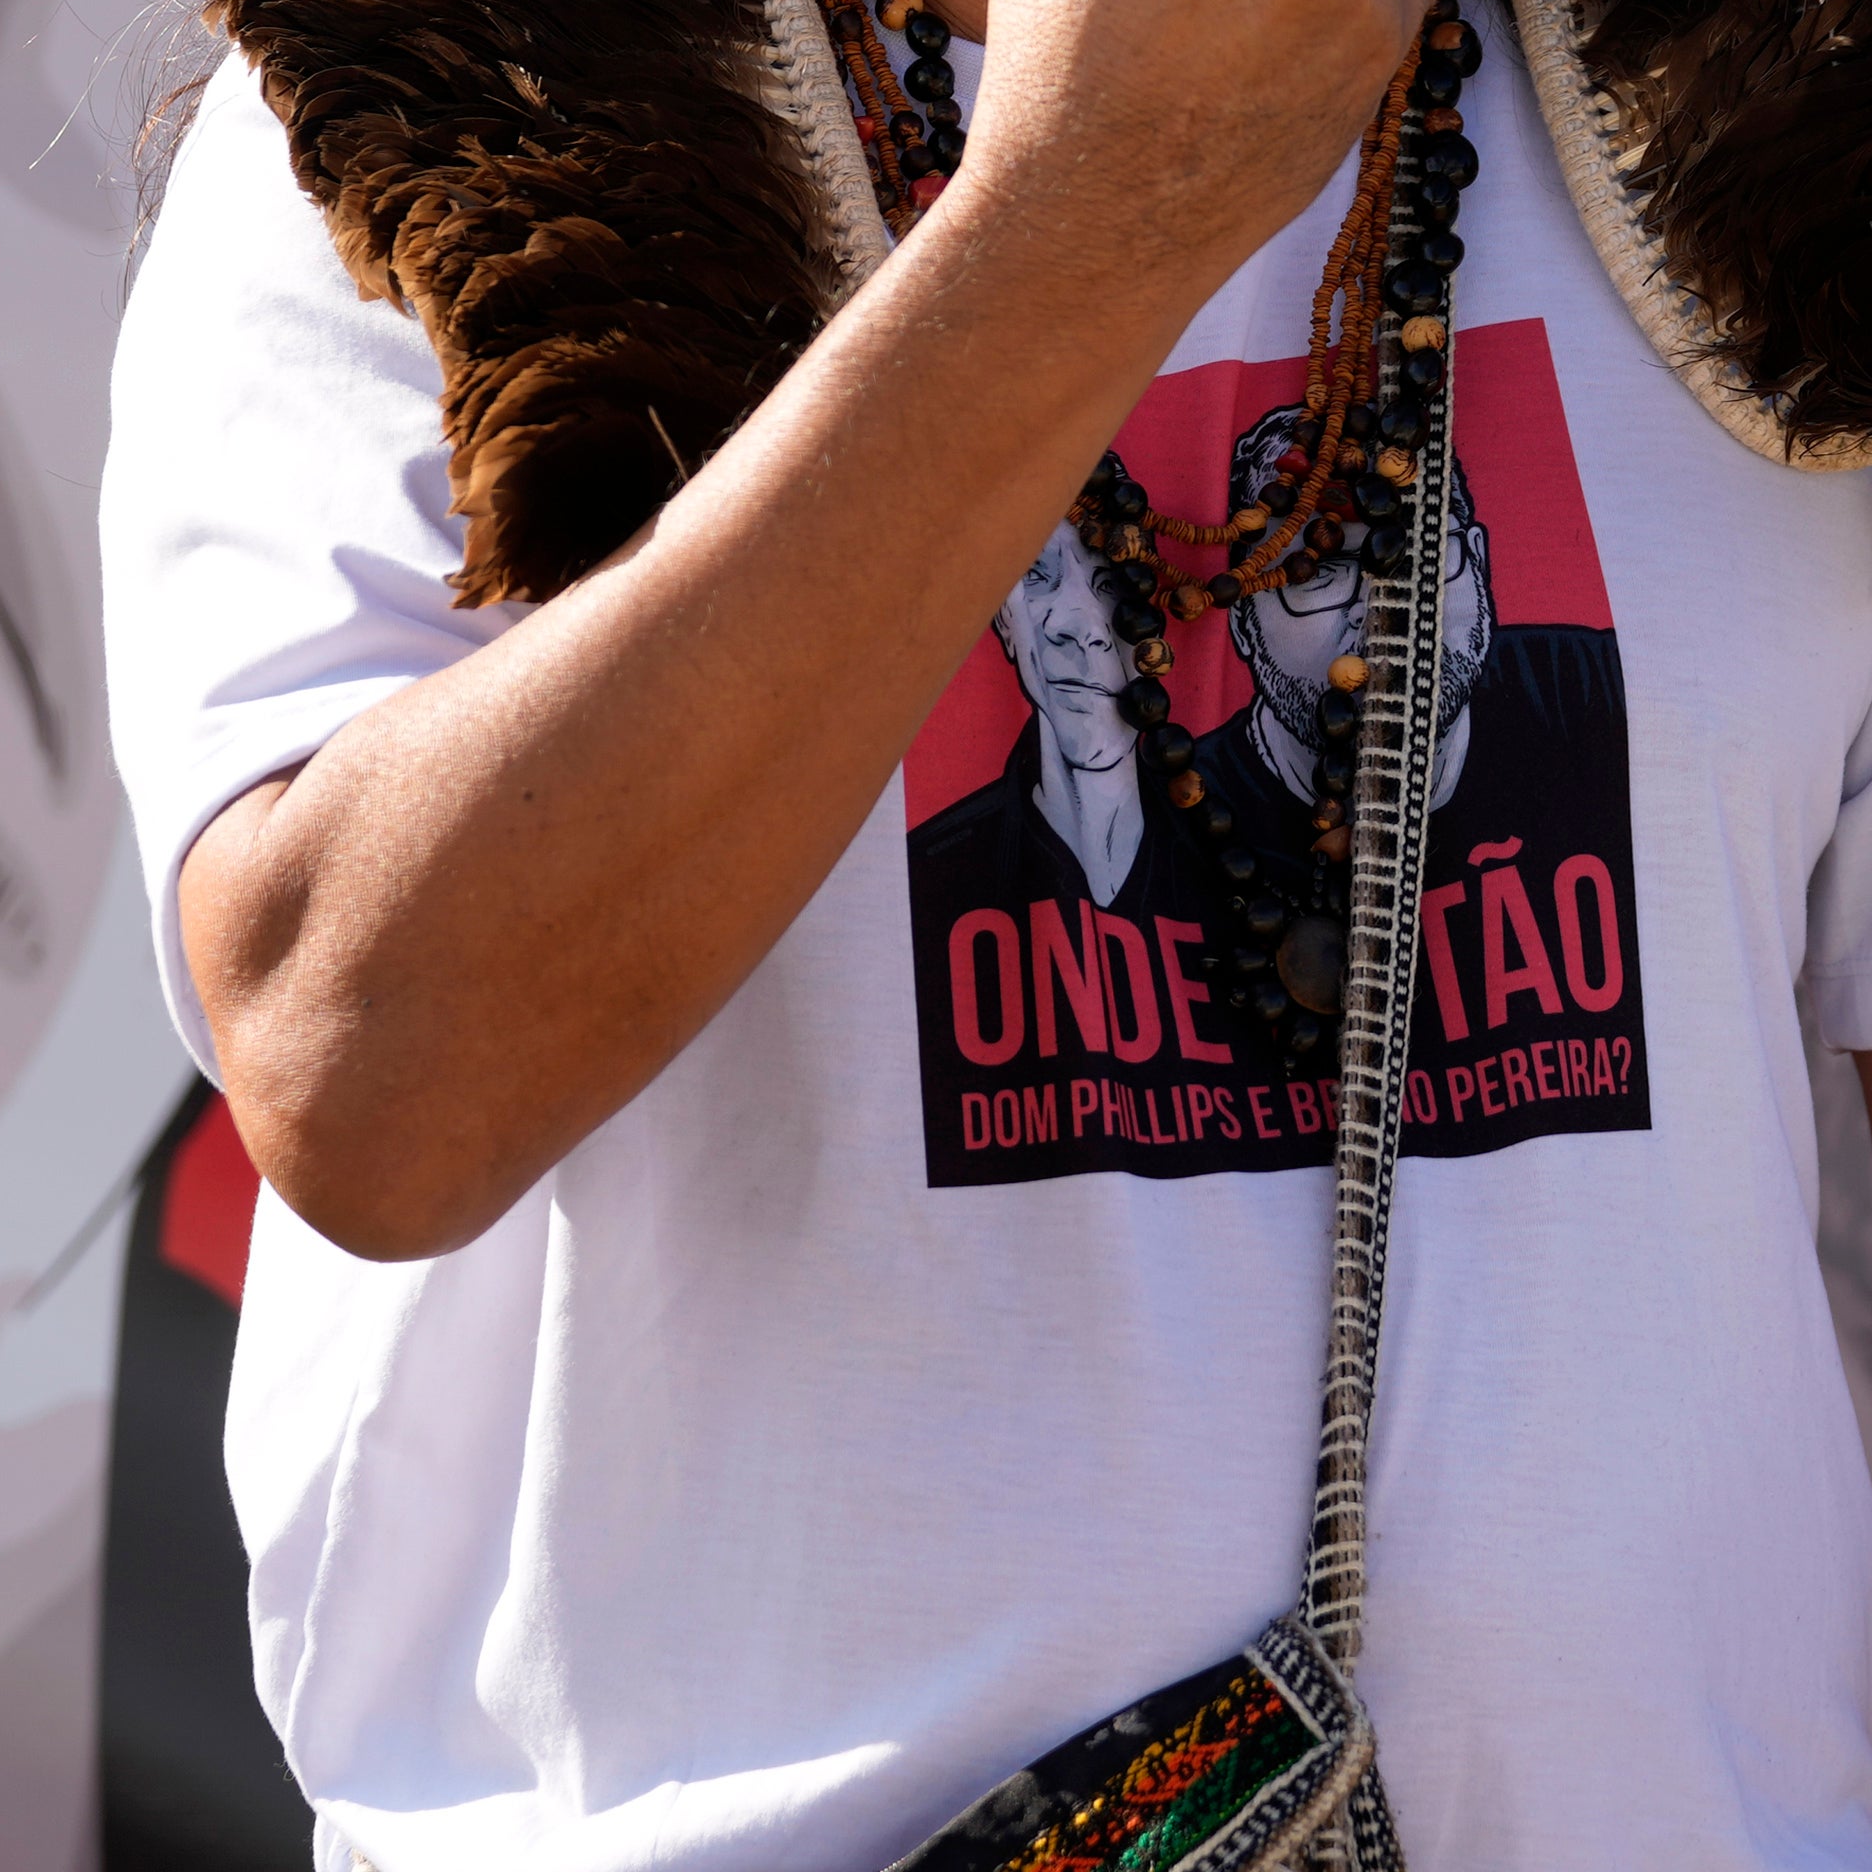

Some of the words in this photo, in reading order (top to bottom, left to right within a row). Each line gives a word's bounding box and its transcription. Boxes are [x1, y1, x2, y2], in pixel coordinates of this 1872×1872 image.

[948, 897, 1235, 1066] ONDE
[1419, 835, 1625, 1042] TÃO
[961, 1083, 1057, 1150] DOM
[1071, 1076, 1242, 1145] PHILLIPS
[1247, 1085, 1282, 1140] E
[1446, 1035, 1633, 1123] PEREIRA?
